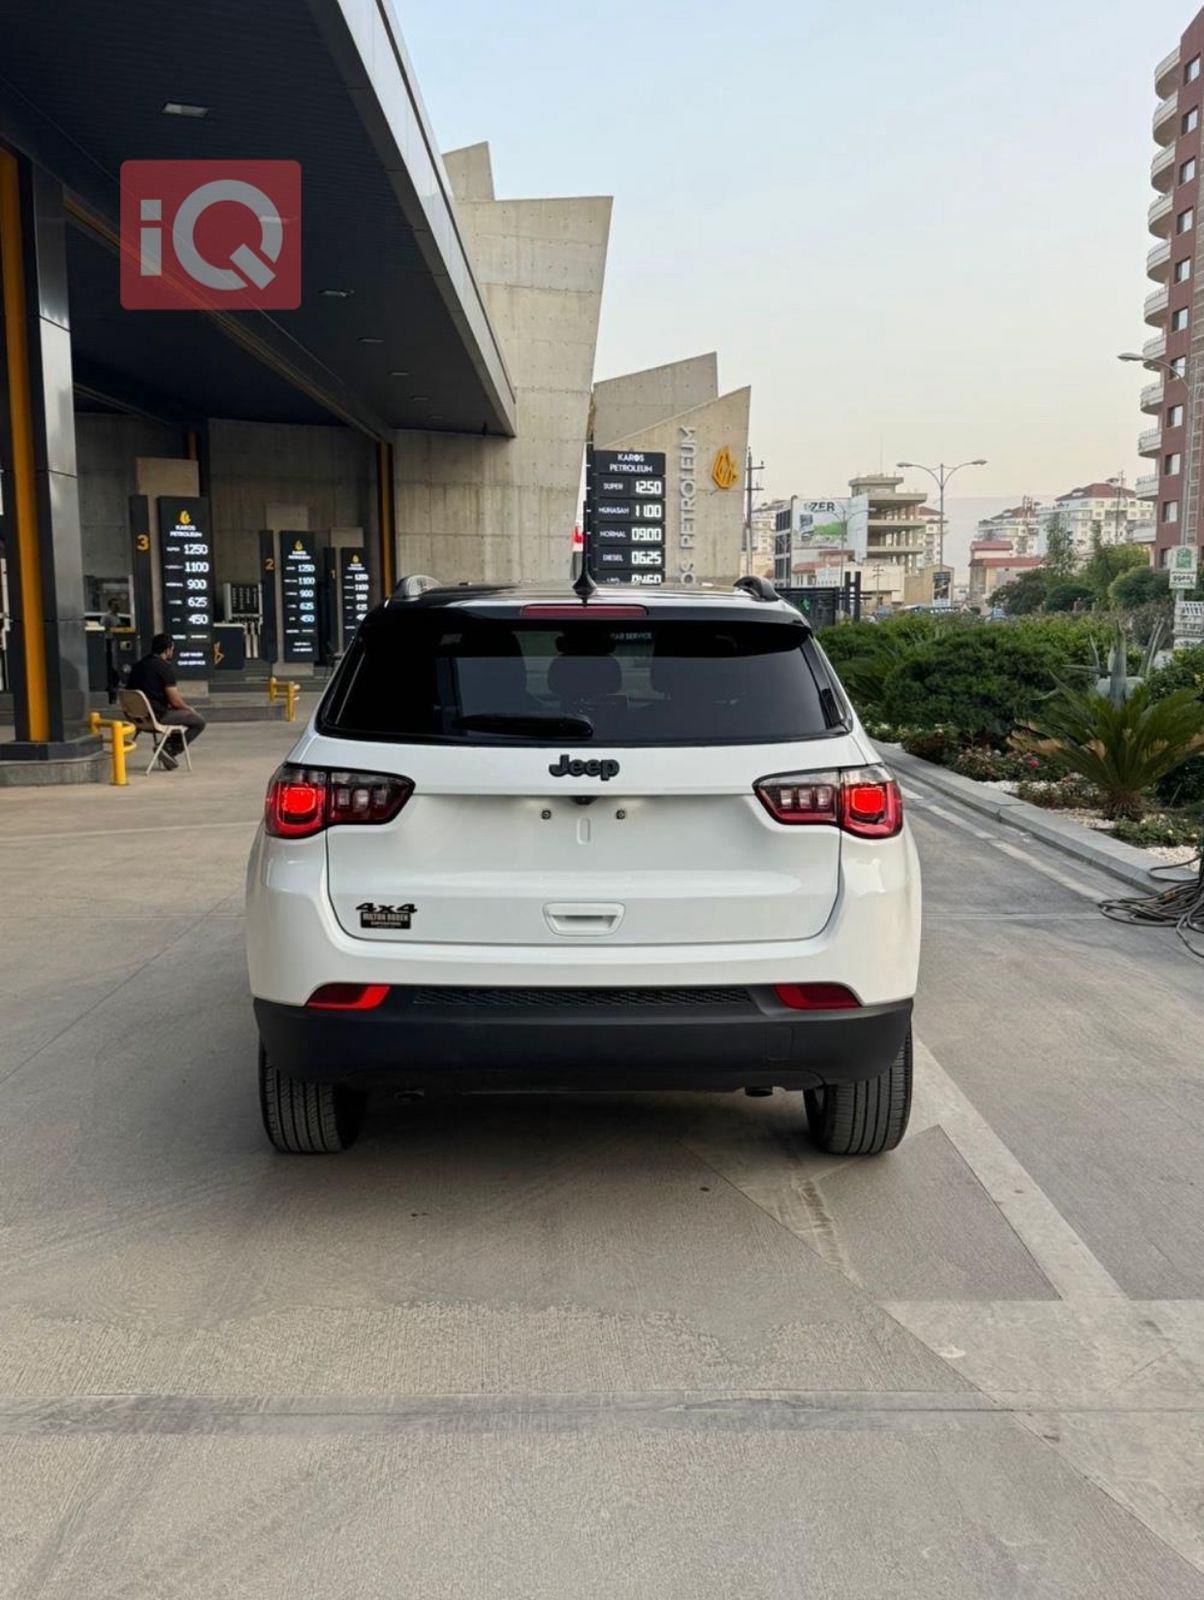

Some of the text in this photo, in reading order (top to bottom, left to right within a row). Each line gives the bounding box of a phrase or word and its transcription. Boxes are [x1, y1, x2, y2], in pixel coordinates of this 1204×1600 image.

[617, 453, 645, 462] KAROS
[609, 463, 653, 472] PETROLEUM
[603, 482, 623, 490] SUPER
[679, 425, 696, 549] PETROLEUM
[600, 530, 626, 538] NORMAL
[137, 534, 149, 550] 3
[183, 543, 209, 555] 1250
[602, 553, 623, 561] DIESEL
[184, 561, 210, 573] 1100
[265, 558, 275, 571] 2
[186, 579, 207, 590] 900
[300, 589, 315, 598] 900
[187, 596, 208, 608] 625
[188, 614, 209, 625] 450
[548, 754, 620, 781] Jeep
[355, 902, 418, 914] 4x4
